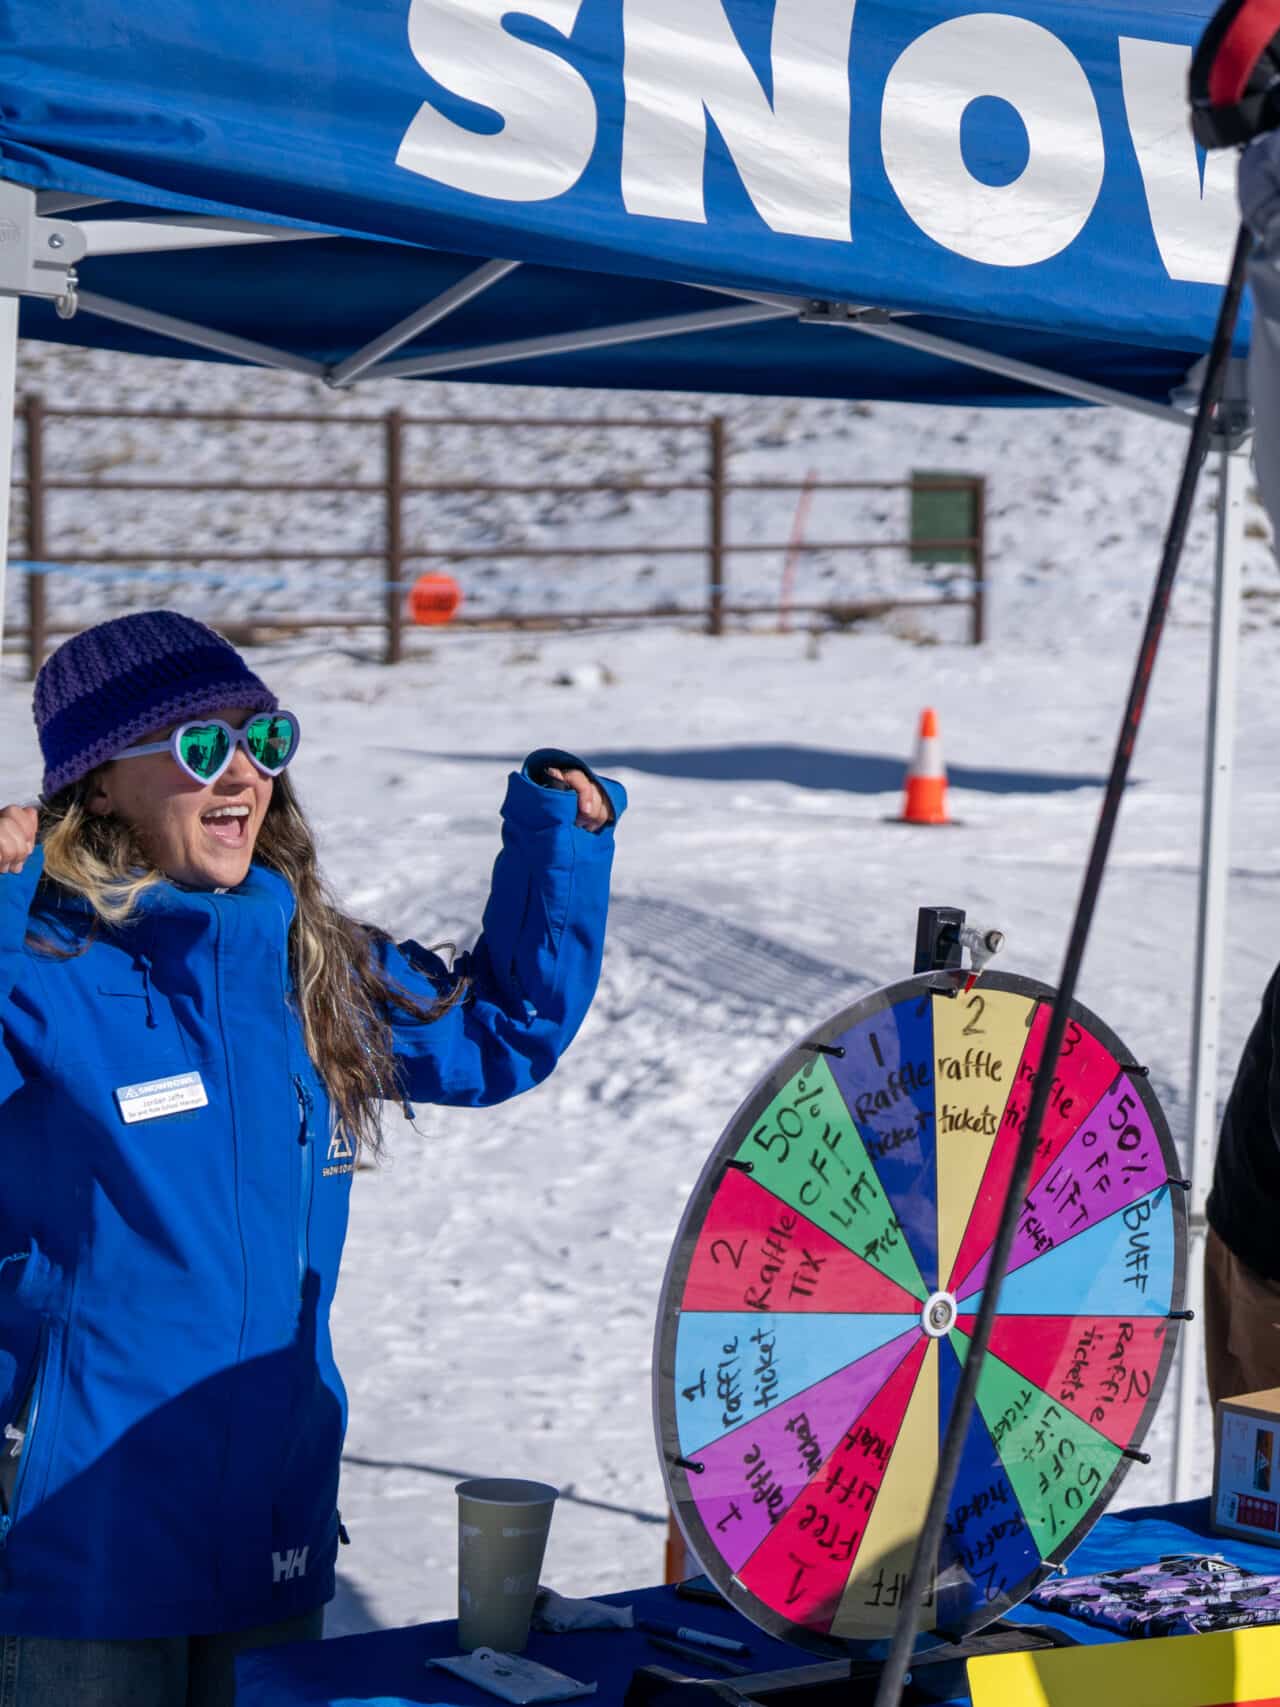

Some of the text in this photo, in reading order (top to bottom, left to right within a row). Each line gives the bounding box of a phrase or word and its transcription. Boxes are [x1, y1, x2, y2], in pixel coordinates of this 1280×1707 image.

[961, 995, 986, 1036] 2
[869, 1032, 884, 1067] 1
[938, 1048, 1003, 1081] raffle
[1020, 1060, 1073, 1118] rafle
[753, 1080, 824, 1164] 50%
[938, 1105, 998, 1136] tickets
[1109, 1094, 1149, 1184] 50%
[1082, 1131, 1111, 1193] OFF
[710, 1239, 748, 1270] 2
[743, 1215, 798, 1310] Raffle
[1123, 1200, 1151, 1293] BUFF
[682, 1368, 706, 1401] 1
[716, 1336, 743, 1428] raffle
[749, 1328, 779, 1408] ticket
[1061, 1325, 1104, 1401] tickets
[1090, 1323, 1134, 1422] Raffle
[1123, 1368, 1150, 1403] 2
[744, 1444, 783, 1525] raffle
[1039, 1438, 1076, 1495] OFF
[716, 1502, 743, 1532] 1
[1040, 1463, 1102, 1536] 50%
[799, 1505, 858, 1560] Free
[957, 1510, 1024, 1568] Raffl
[272, 1546, 309, 1583] HH
[785, 1552, 817, 1604] 1
[864, 1565, 935, 1609] FF
[970, 1562, 1007, 1602] 2
